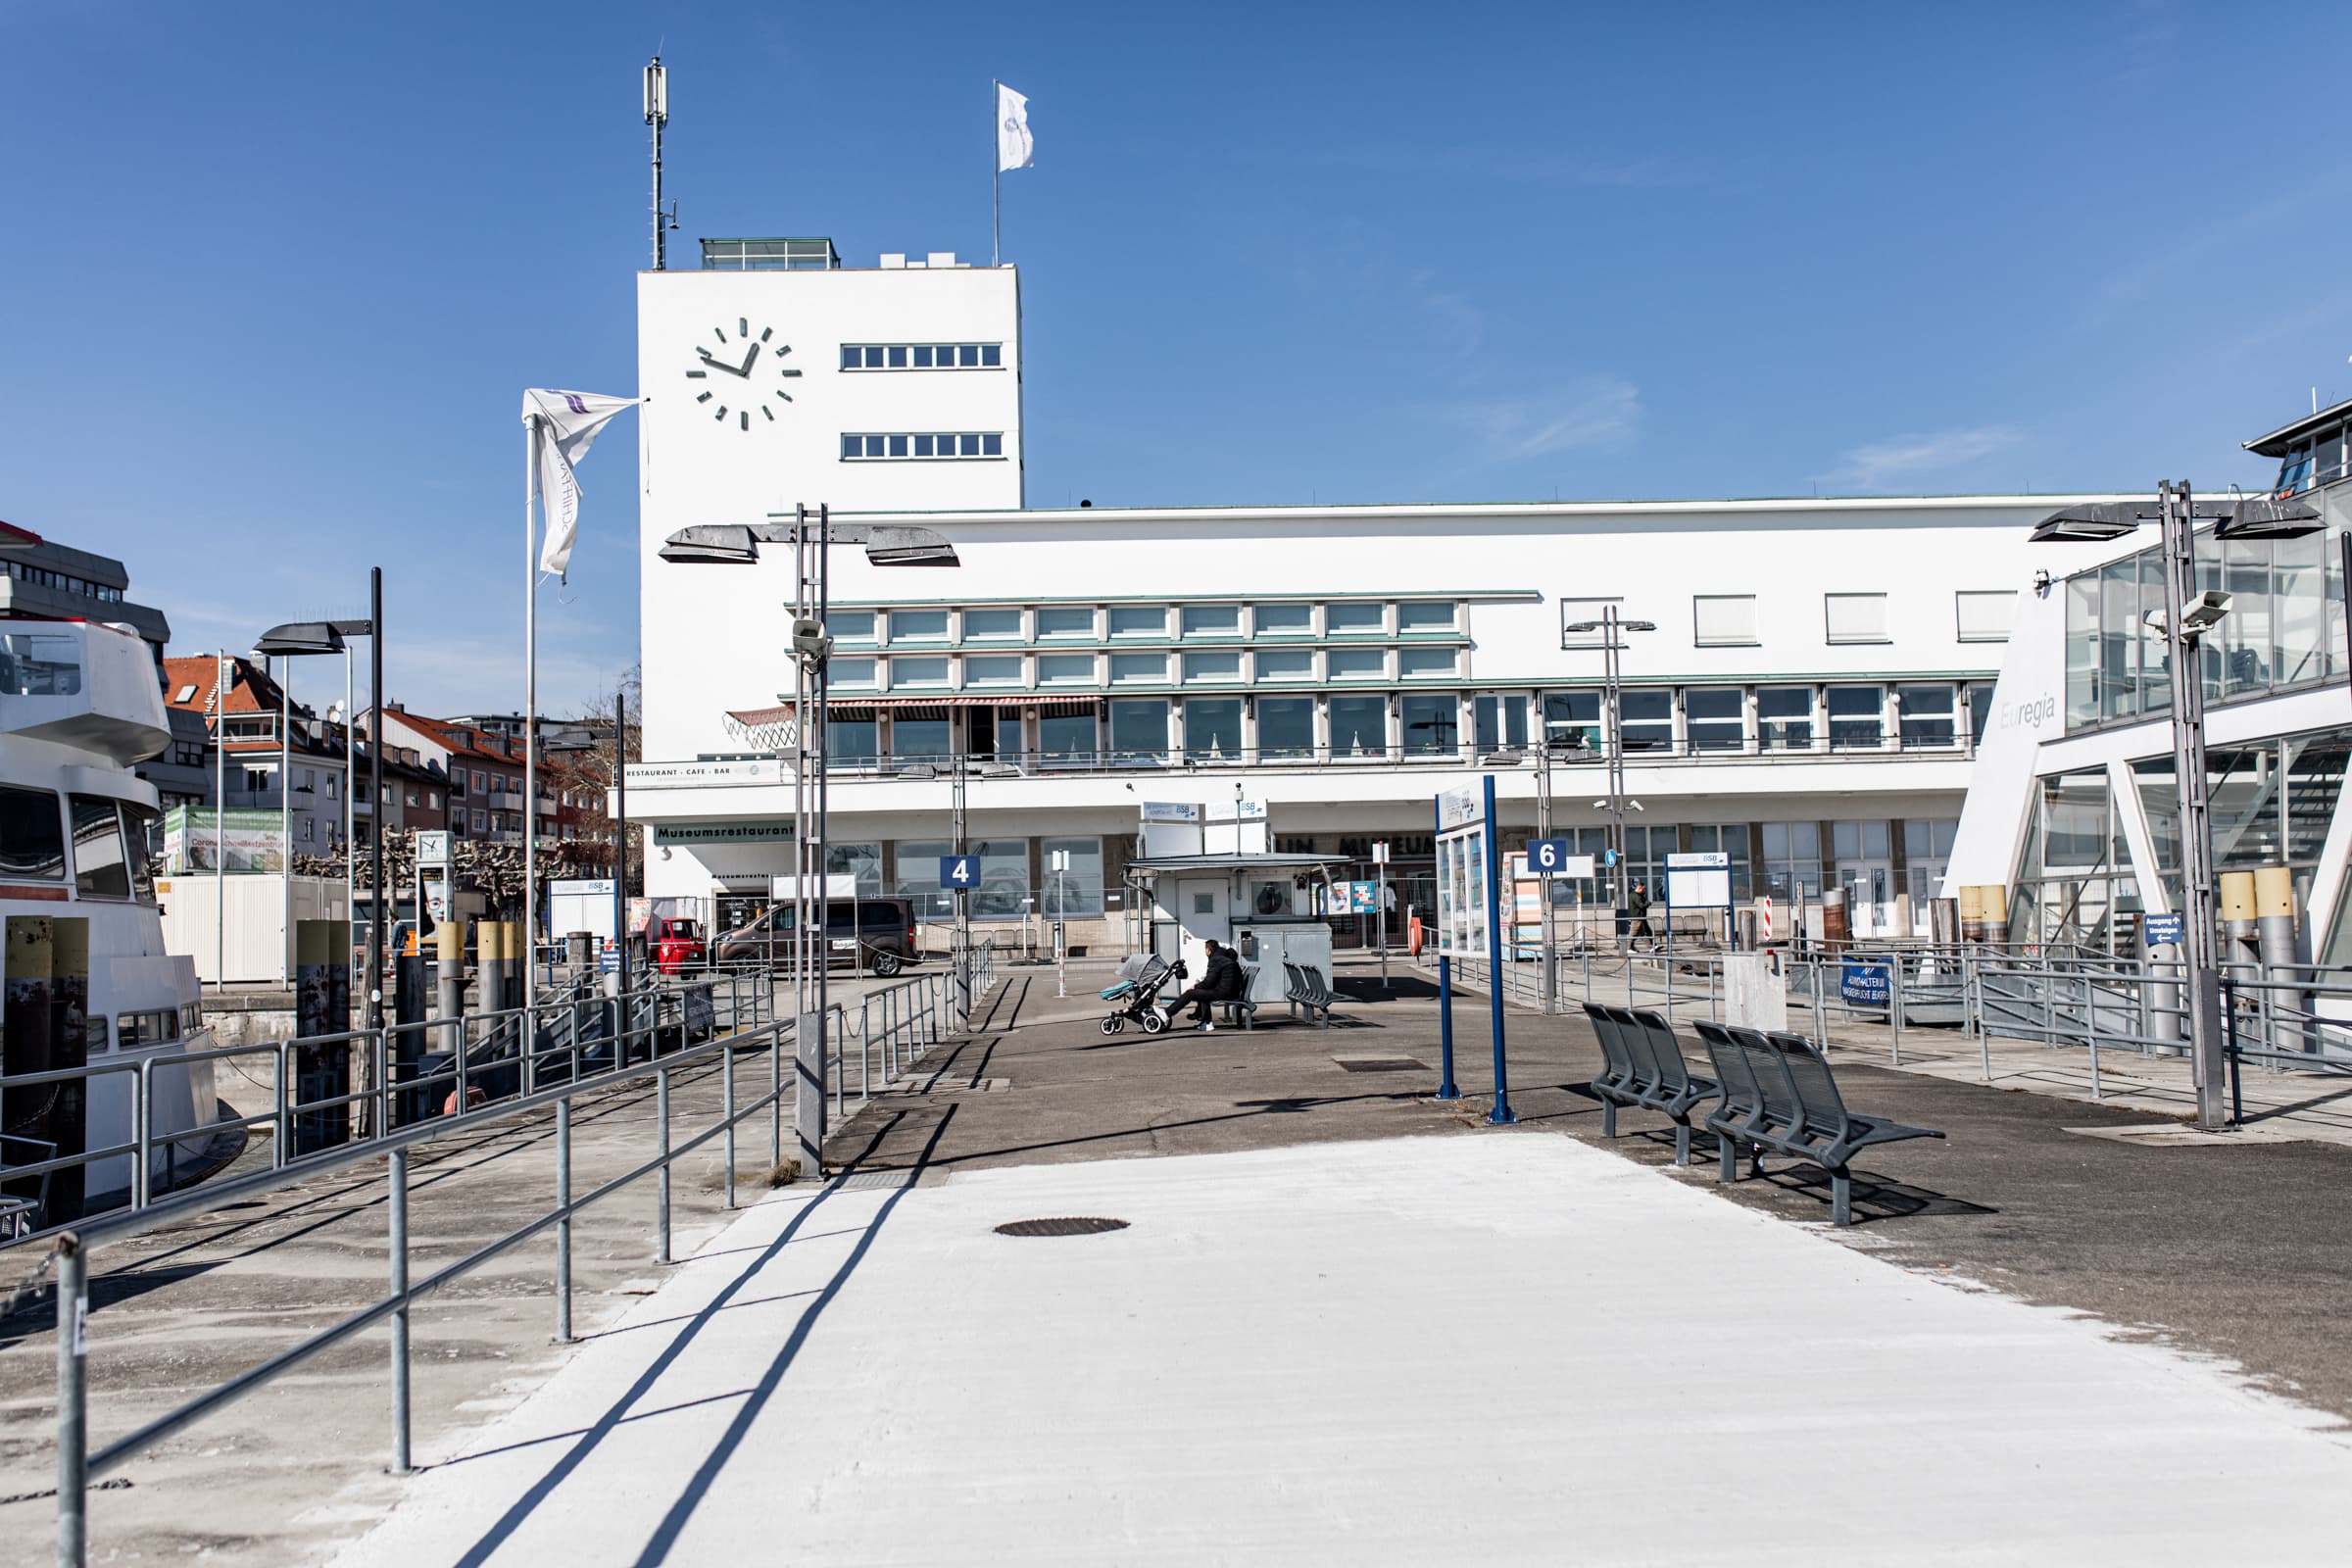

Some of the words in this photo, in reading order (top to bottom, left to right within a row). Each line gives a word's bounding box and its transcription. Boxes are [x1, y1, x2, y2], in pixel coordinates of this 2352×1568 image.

[2000, 692, 2055, 729] Euregia
[1176, 805, 1190, 813] BSB
[658, 825, 795, 839] Museumsrestaurant
[1540, 844, 1555, 866] 6
[952, 859, 969, 882] 4
